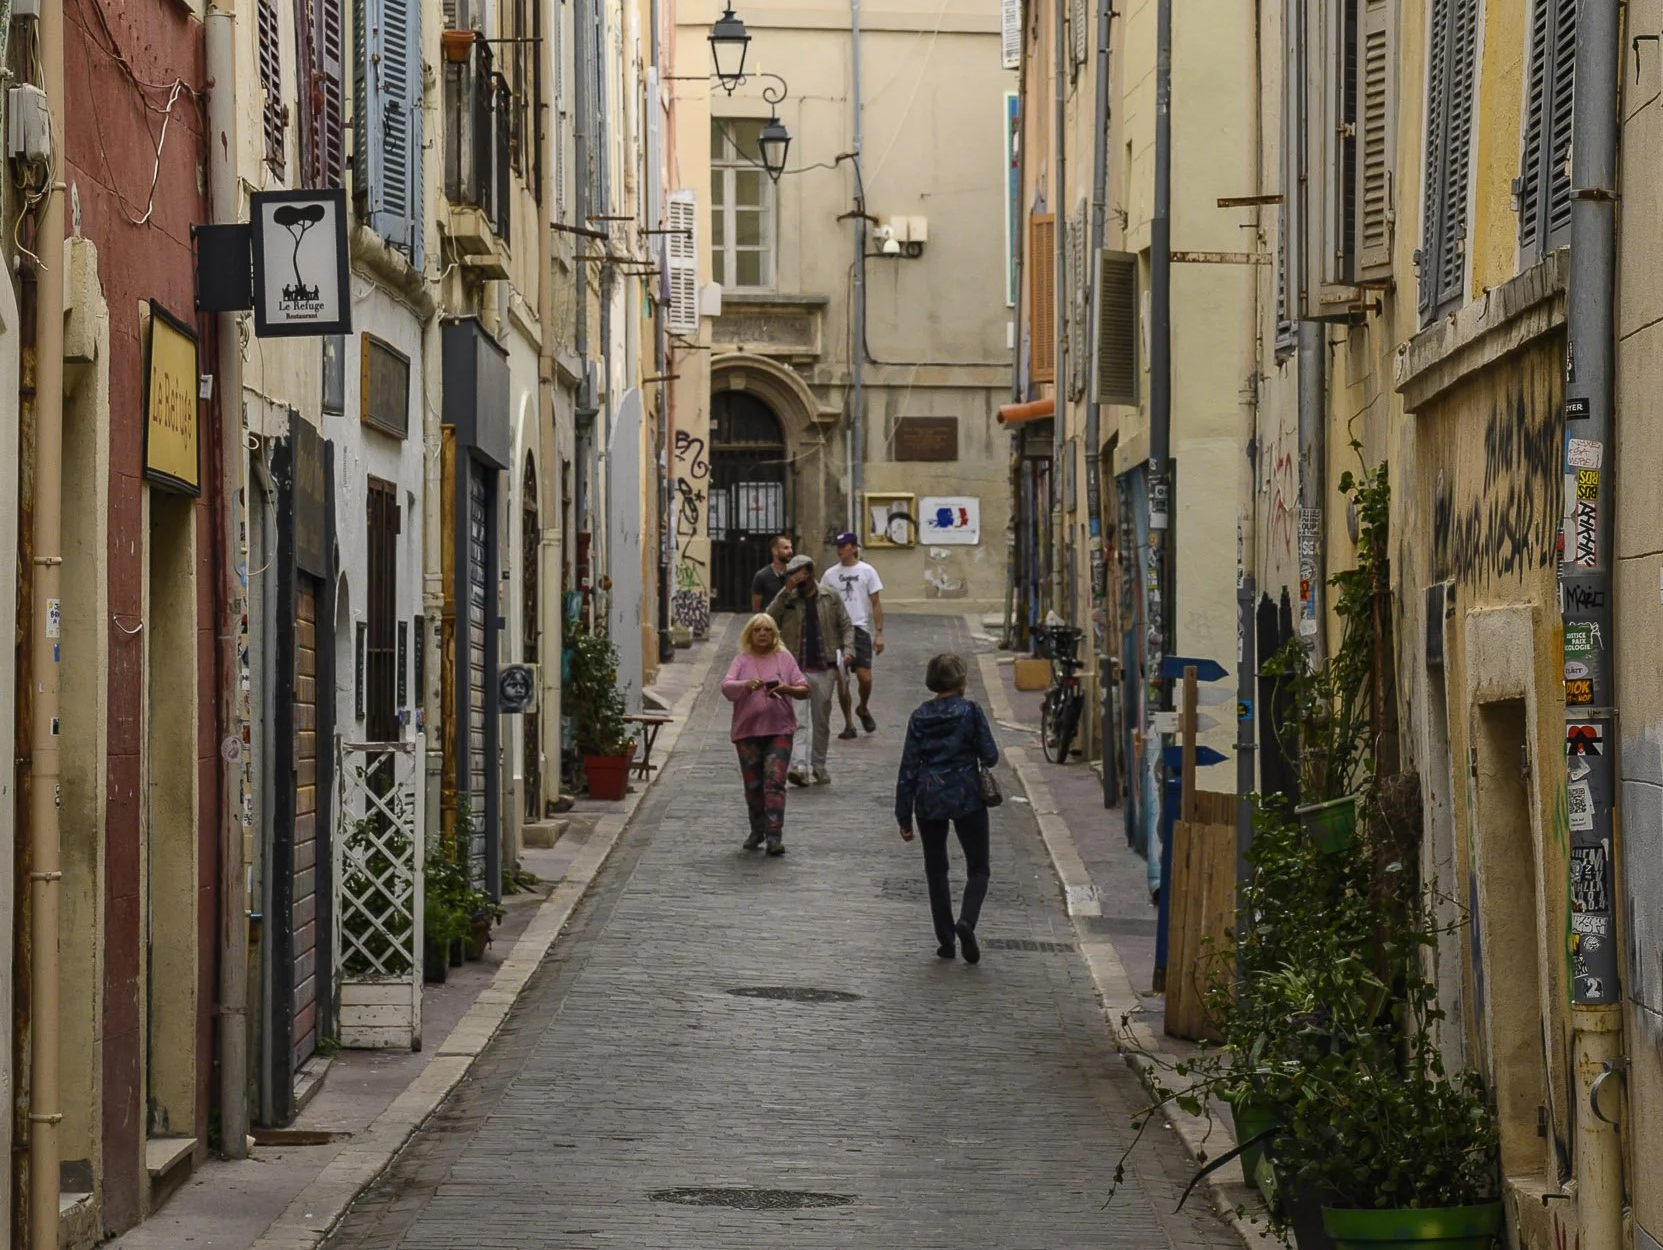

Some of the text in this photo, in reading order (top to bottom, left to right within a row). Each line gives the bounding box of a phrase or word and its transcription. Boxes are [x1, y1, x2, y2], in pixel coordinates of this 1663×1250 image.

[279, 300, 324, 312] Le Refuge
[152, 366, 192, 451] Le Refuge
